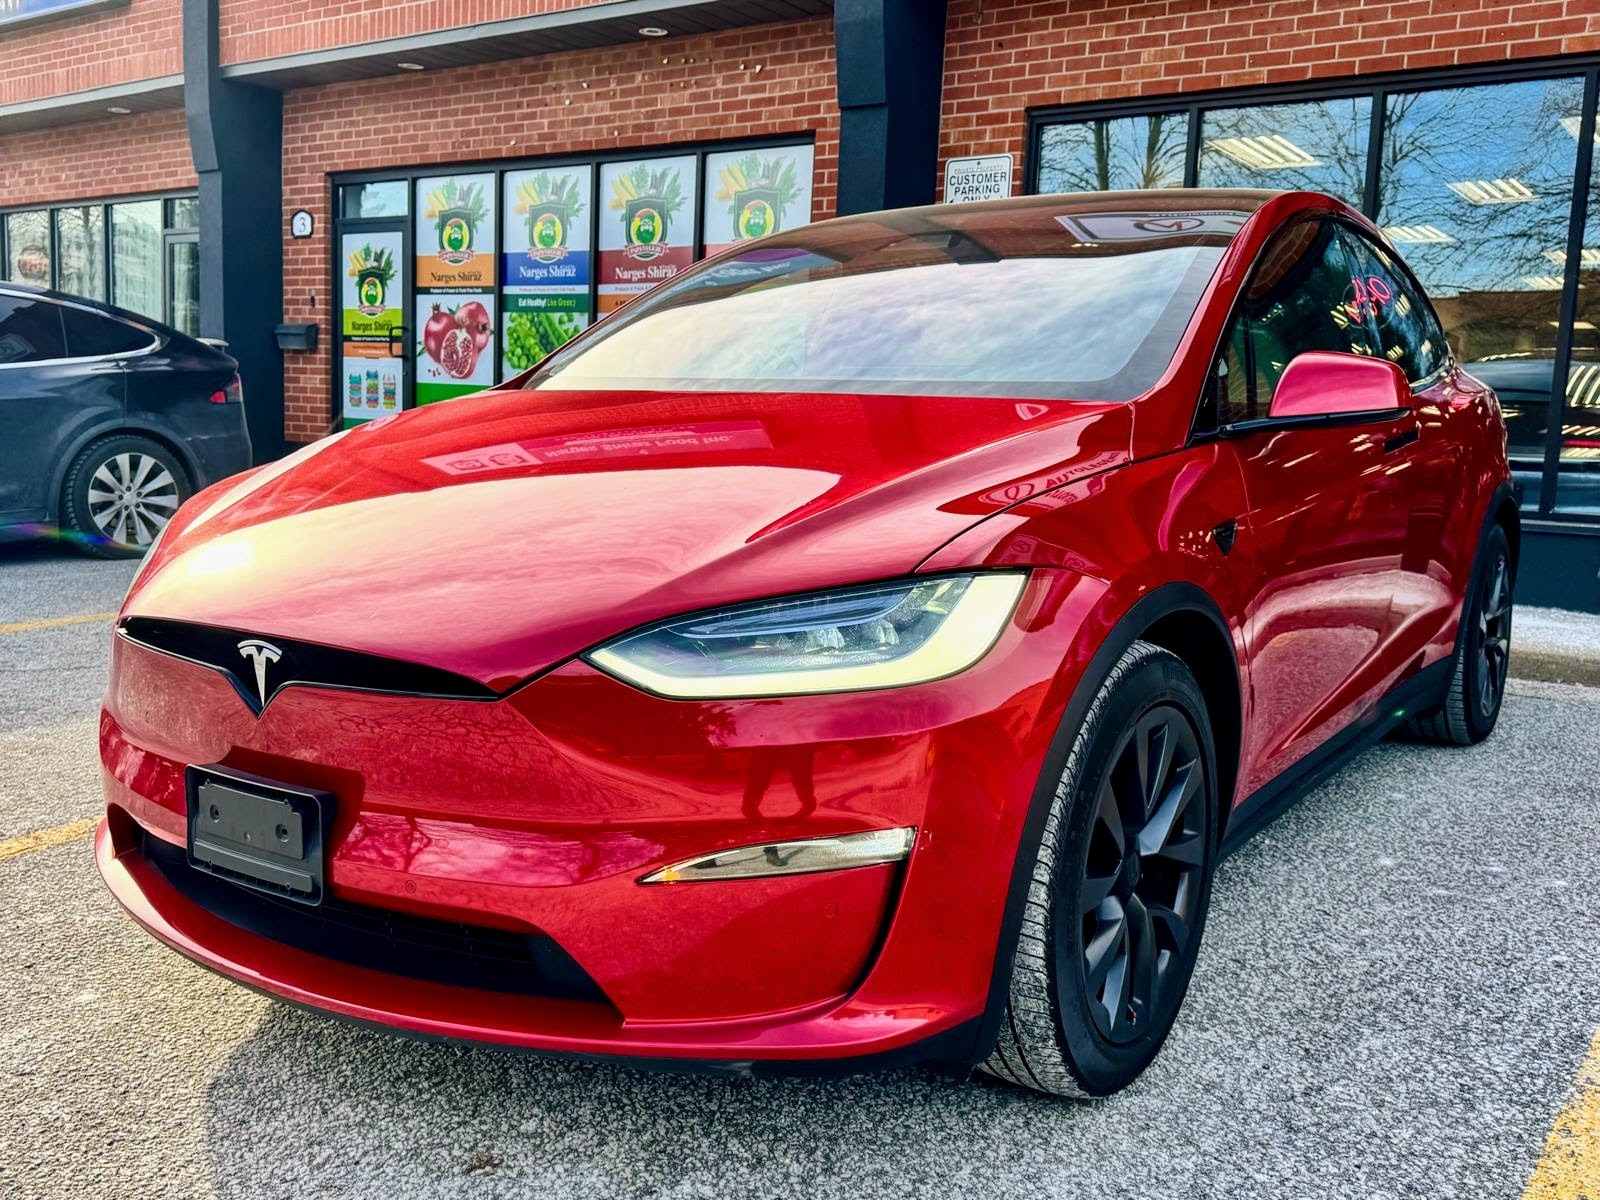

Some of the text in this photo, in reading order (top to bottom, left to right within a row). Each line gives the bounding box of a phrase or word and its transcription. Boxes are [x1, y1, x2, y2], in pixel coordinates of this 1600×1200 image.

[949, 172, 1007, 186] CUSTOMER
[954, 184, 1000, 196] PARKING
[299, 217, 306, 233] 3
[430, 271, 482, 284] Narges Shiraz
[519, 264, 576, 280] Narges Shiraz
[614, 264, 677, 282] Narges Shiraz
[351, 321, 373, 333] Narges
